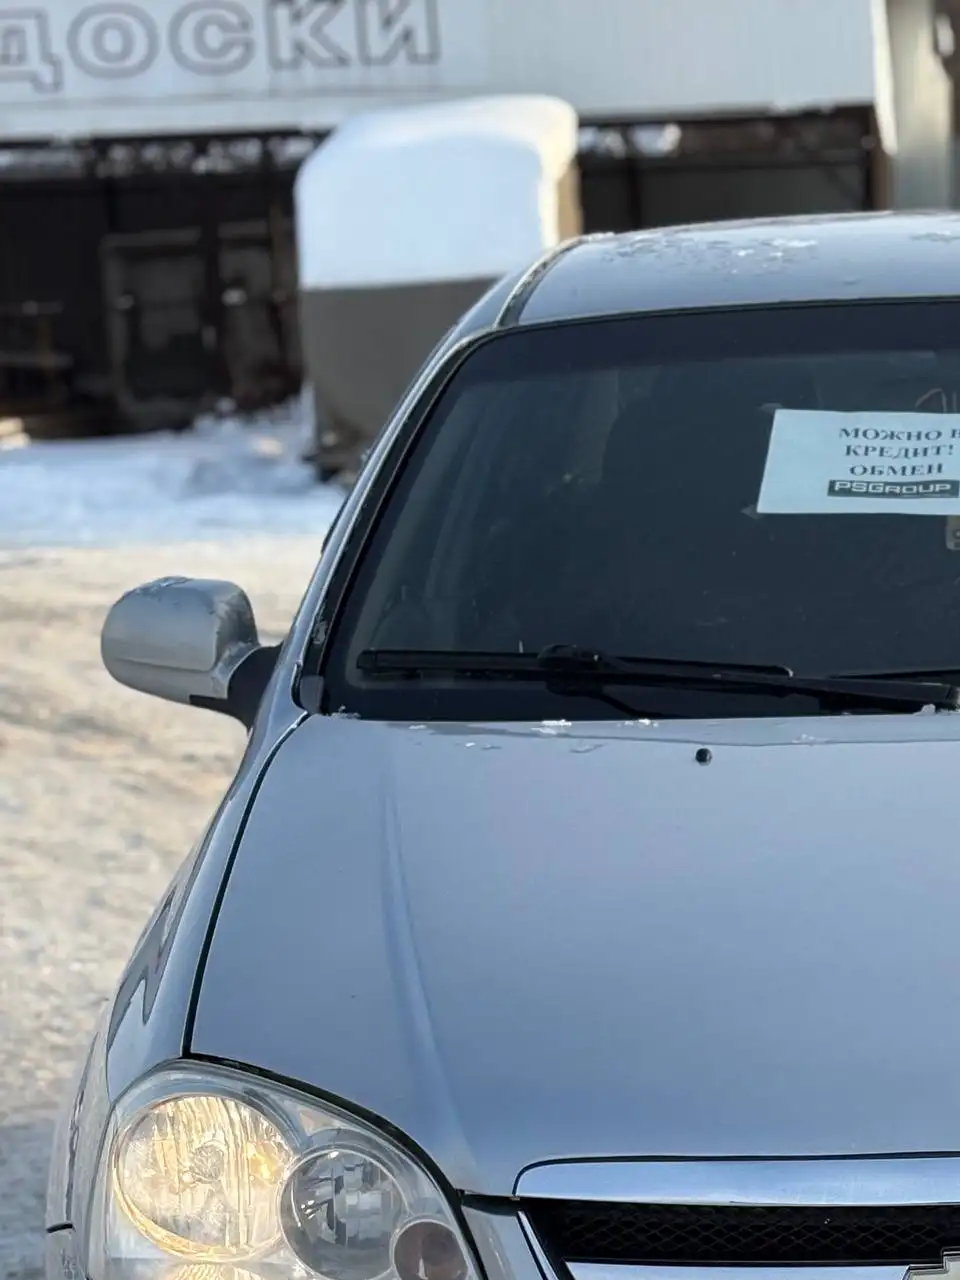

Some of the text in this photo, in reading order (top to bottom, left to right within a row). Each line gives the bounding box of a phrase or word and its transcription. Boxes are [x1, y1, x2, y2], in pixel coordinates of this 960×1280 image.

[839, 427, 943, 441] МОЖНО
[844, 444, 955, 460] КРЕДИТ!
[849, 462, 944, 476] ОБМЕН
